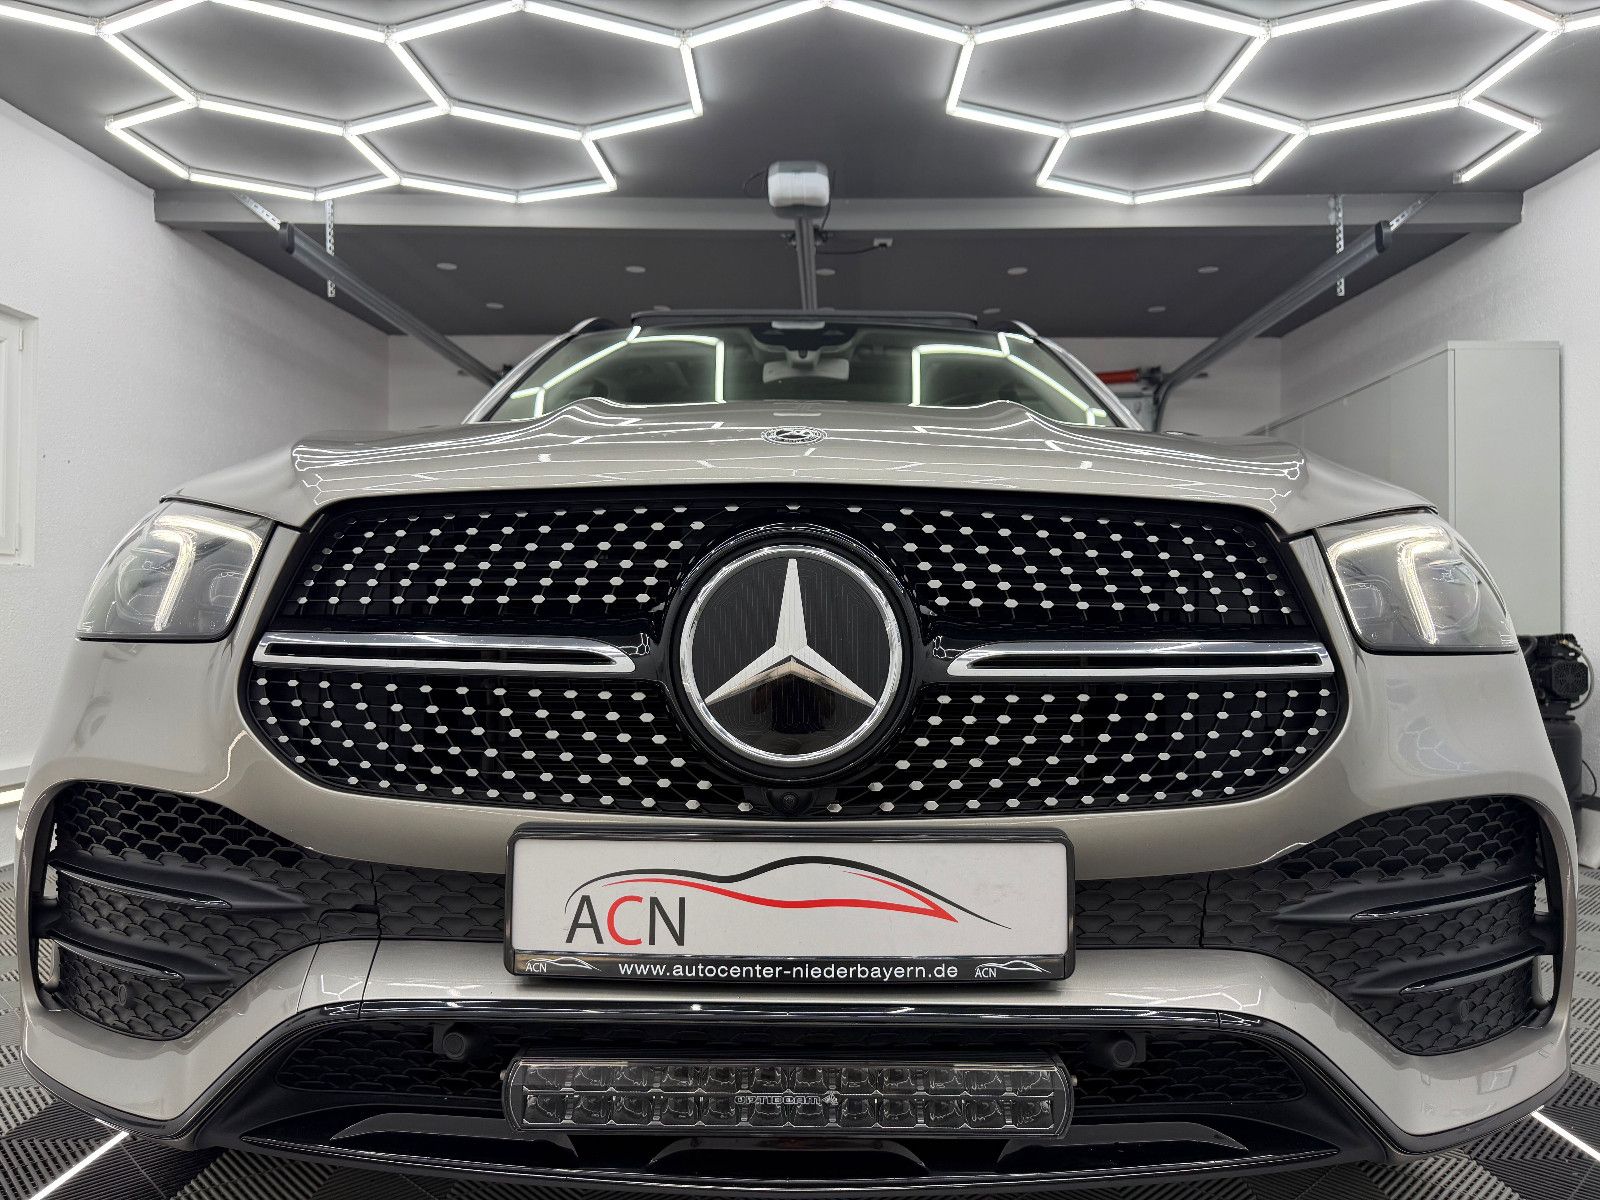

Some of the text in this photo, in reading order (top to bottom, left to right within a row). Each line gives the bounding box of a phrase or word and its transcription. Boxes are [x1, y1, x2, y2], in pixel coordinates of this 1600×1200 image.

[565, 894, 686, 947] ACN
[525, 962, 547, 973] ACN
[618, 962, 958, 981] www.autocenter-niederbayern.de
[975, 967, 997, 978] ACN
